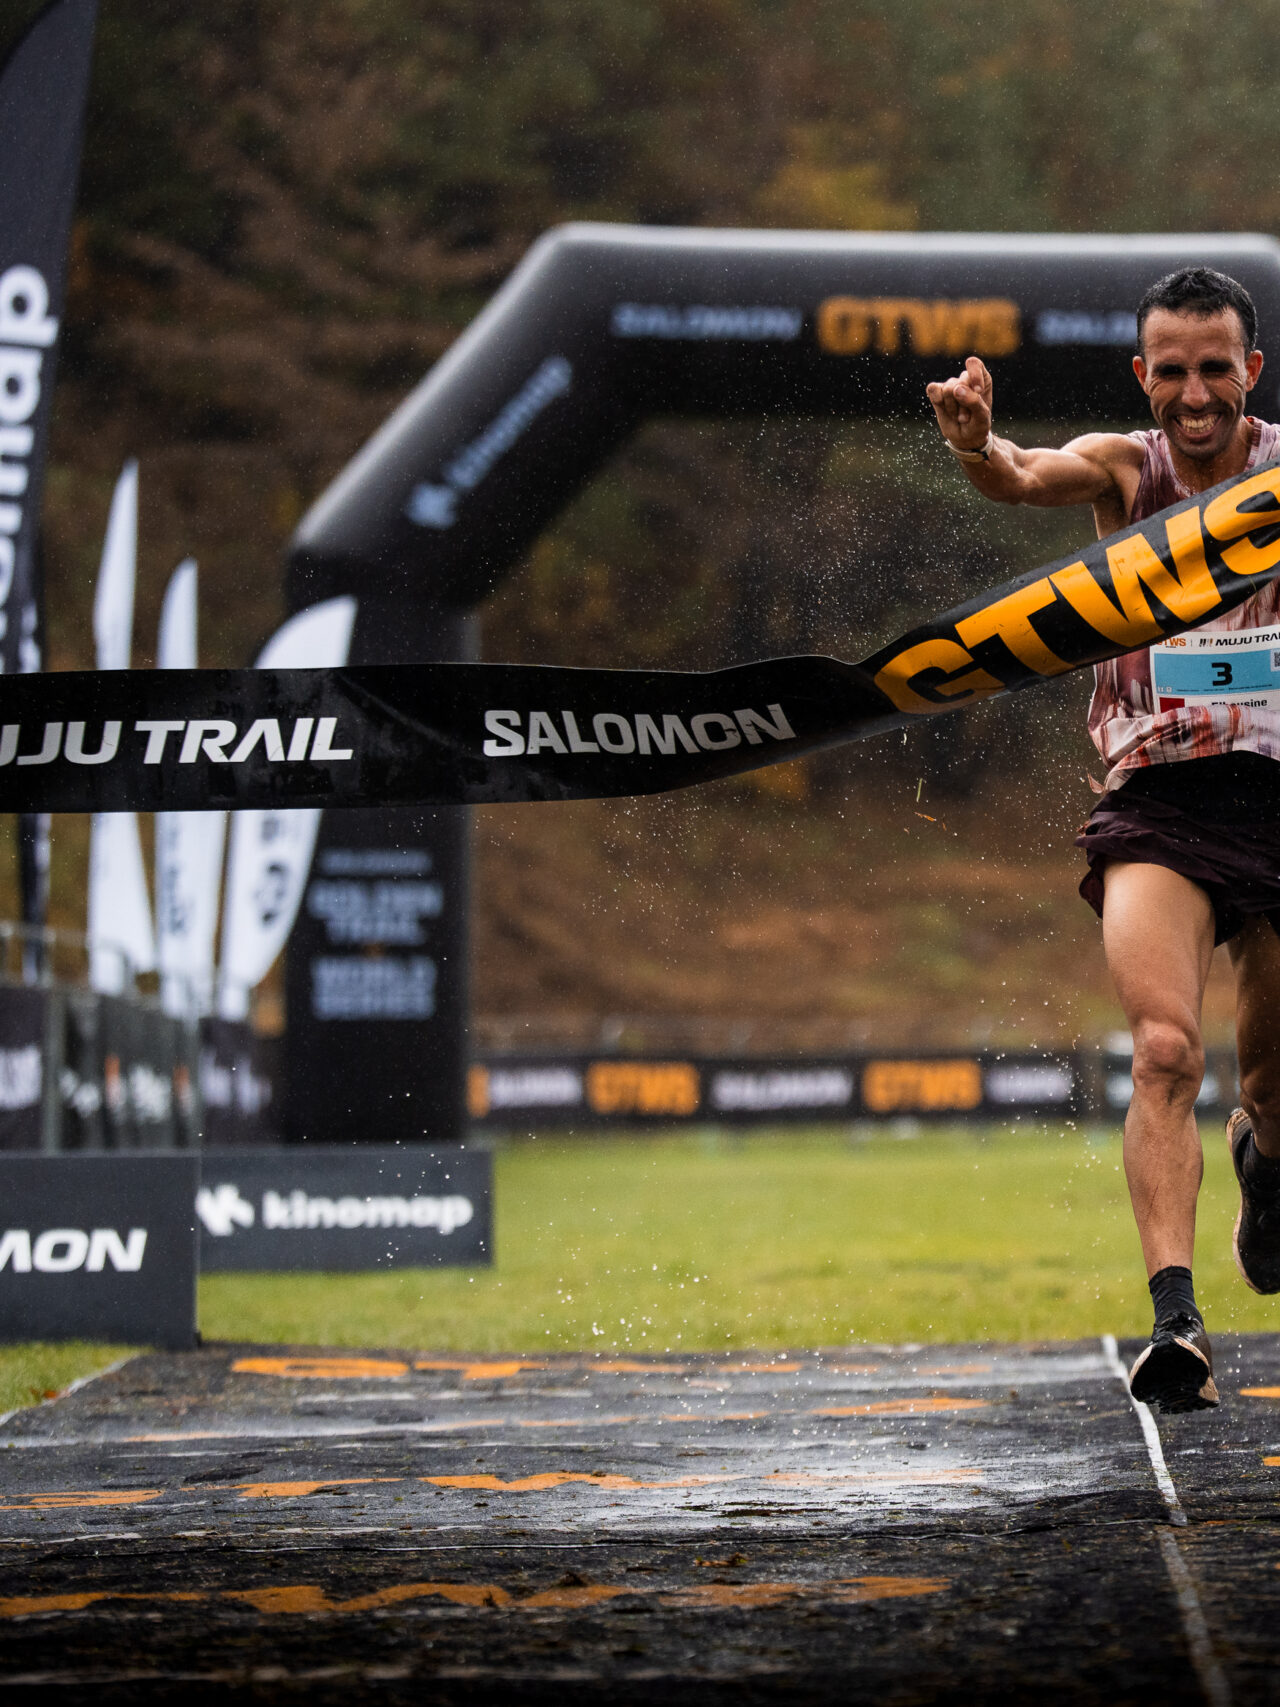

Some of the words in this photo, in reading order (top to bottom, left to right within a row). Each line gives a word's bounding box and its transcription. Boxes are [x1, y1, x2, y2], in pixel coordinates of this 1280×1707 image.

[1215, 636, 1253, 647] MUJU
[1211, 662, 1233, 686] 3
[134, 717, 353, 764] TRAIL
[483, 703, 797, 757] SALOMON
[263, 1190, 474, 1236] kinomap
